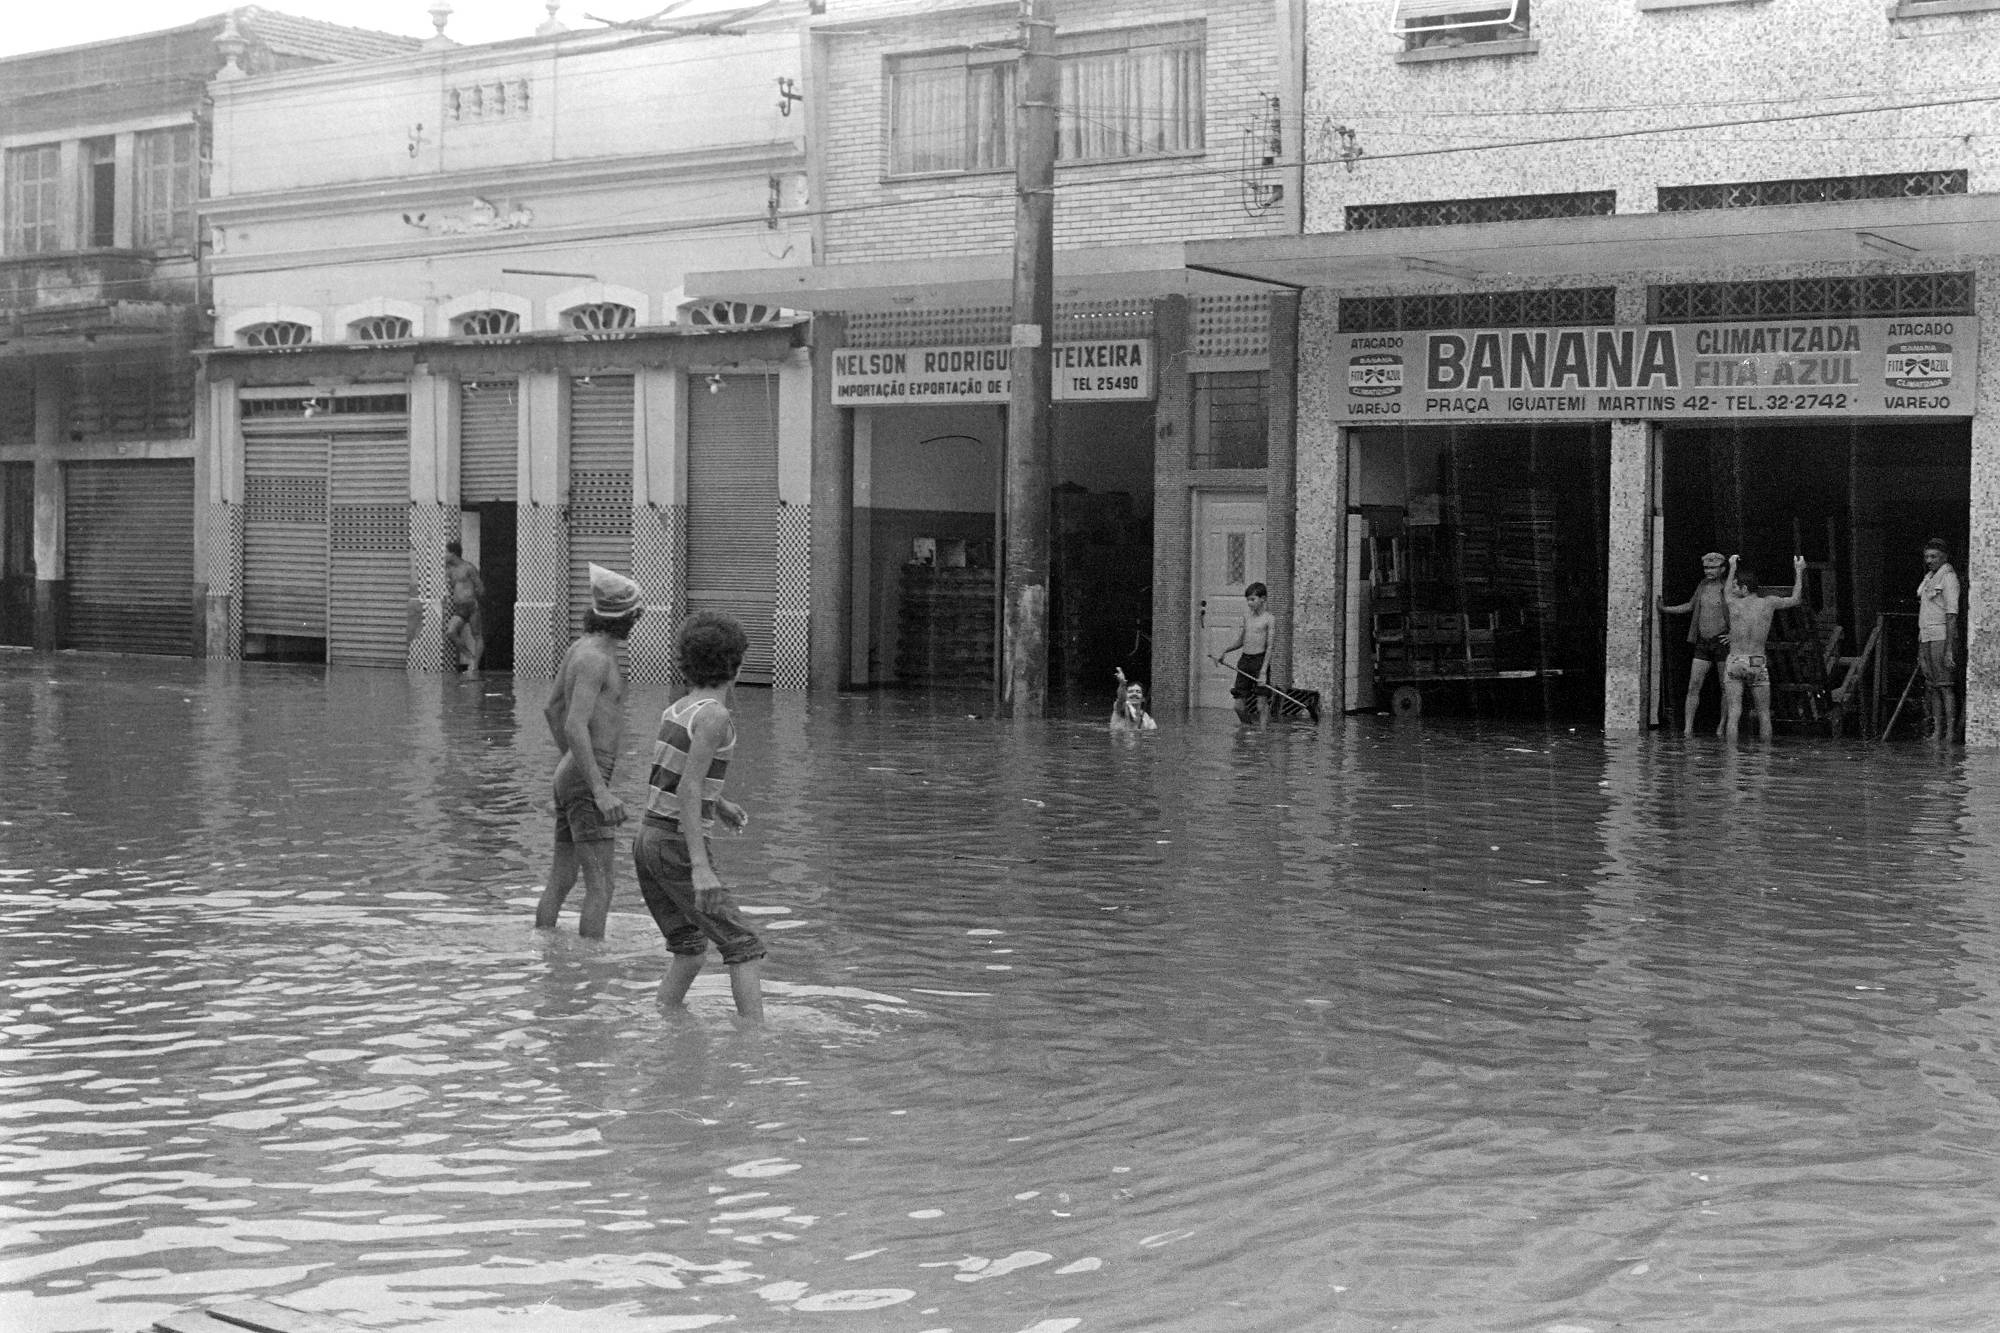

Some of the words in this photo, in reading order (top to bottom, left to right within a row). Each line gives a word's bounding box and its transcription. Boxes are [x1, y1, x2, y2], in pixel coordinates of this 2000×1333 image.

[1888, 323, 1954, 336] ATACADO
[1351, 337, 1404, 350] ATACADO
[1697, 325, 1860, 354] CLIMATIZADA
[836, 352, 906, 376] NELSON
[1053, 344, 1142, 369] TEIXEIRA
[1427, 328, 1681, 390] BANANA
[1695, 360, 1758, 387] FITA
[1772, 358, 1859, 385] AZUL
[838, 380, 905, 398] IMPORTAÇÃO
[909, 378, 982, 397] EXPORTAÇÃO
[988, 381, 1001, 393] DE
[1073, 377, 1092, 391] TEL
[1097, 376, 1138, 391] 25490
[1348, 402, 1401, 415] VAREJO
[1426, 397, 1489, 413] PRAÇA
[1508, 396, 1585, 411] IGUATEMI
[1598, 396, 1676, 411] MARTINS
[1884, 396, 1950, 409] VAREJO
